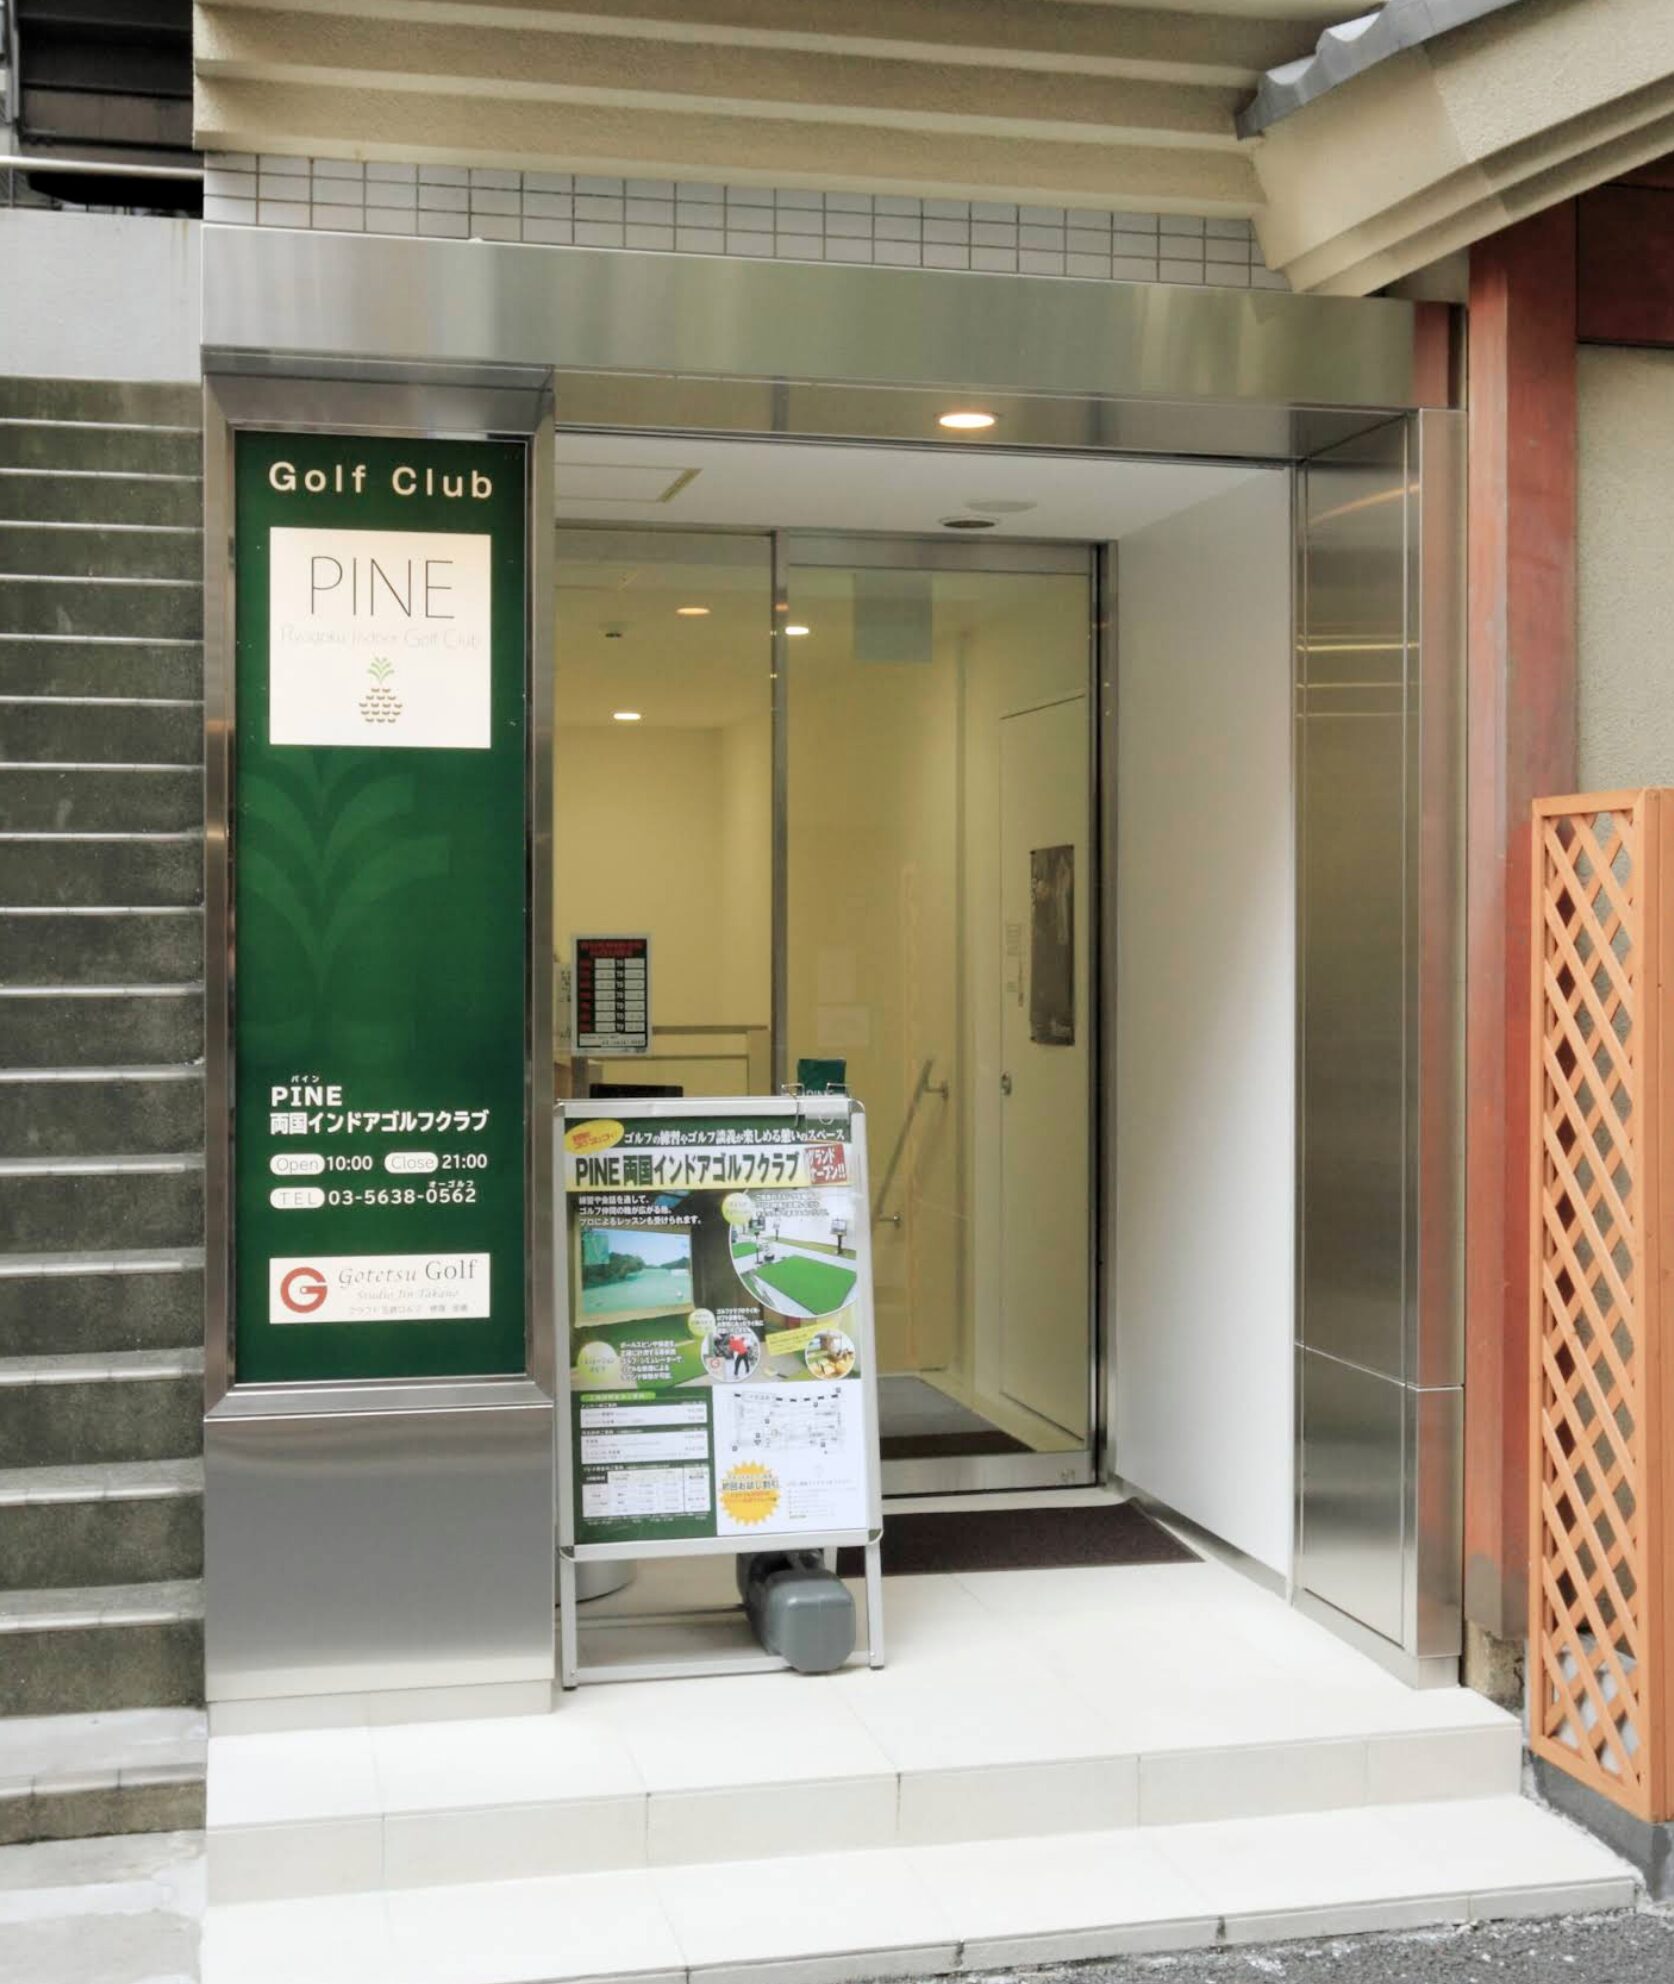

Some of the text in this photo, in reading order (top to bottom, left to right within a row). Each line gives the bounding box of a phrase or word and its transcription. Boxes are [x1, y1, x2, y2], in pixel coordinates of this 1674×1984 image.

[269, 461, 492, 498] Golf Club
[311, 556, 455, 619] PINE
[404, 627, 439, 648] Golf
[443, 628, 481, 649] Club
[291, 1075, 319, 1083] パイン
[271, 1086, 342, 1107] PINE
[270, 1110, 489, 1135] 両国インドアゴルフクラブ
[276, 1154, 488, 1174] Open 10:00 Close 21:00
[575, 1151, 800, 1186] PINE 両国インドアゴルフクラブ
[280, 1188, 476, 1206] TEL 03-5638-0562
[338, 1259, 478, 1288] Gotetsu Golf
